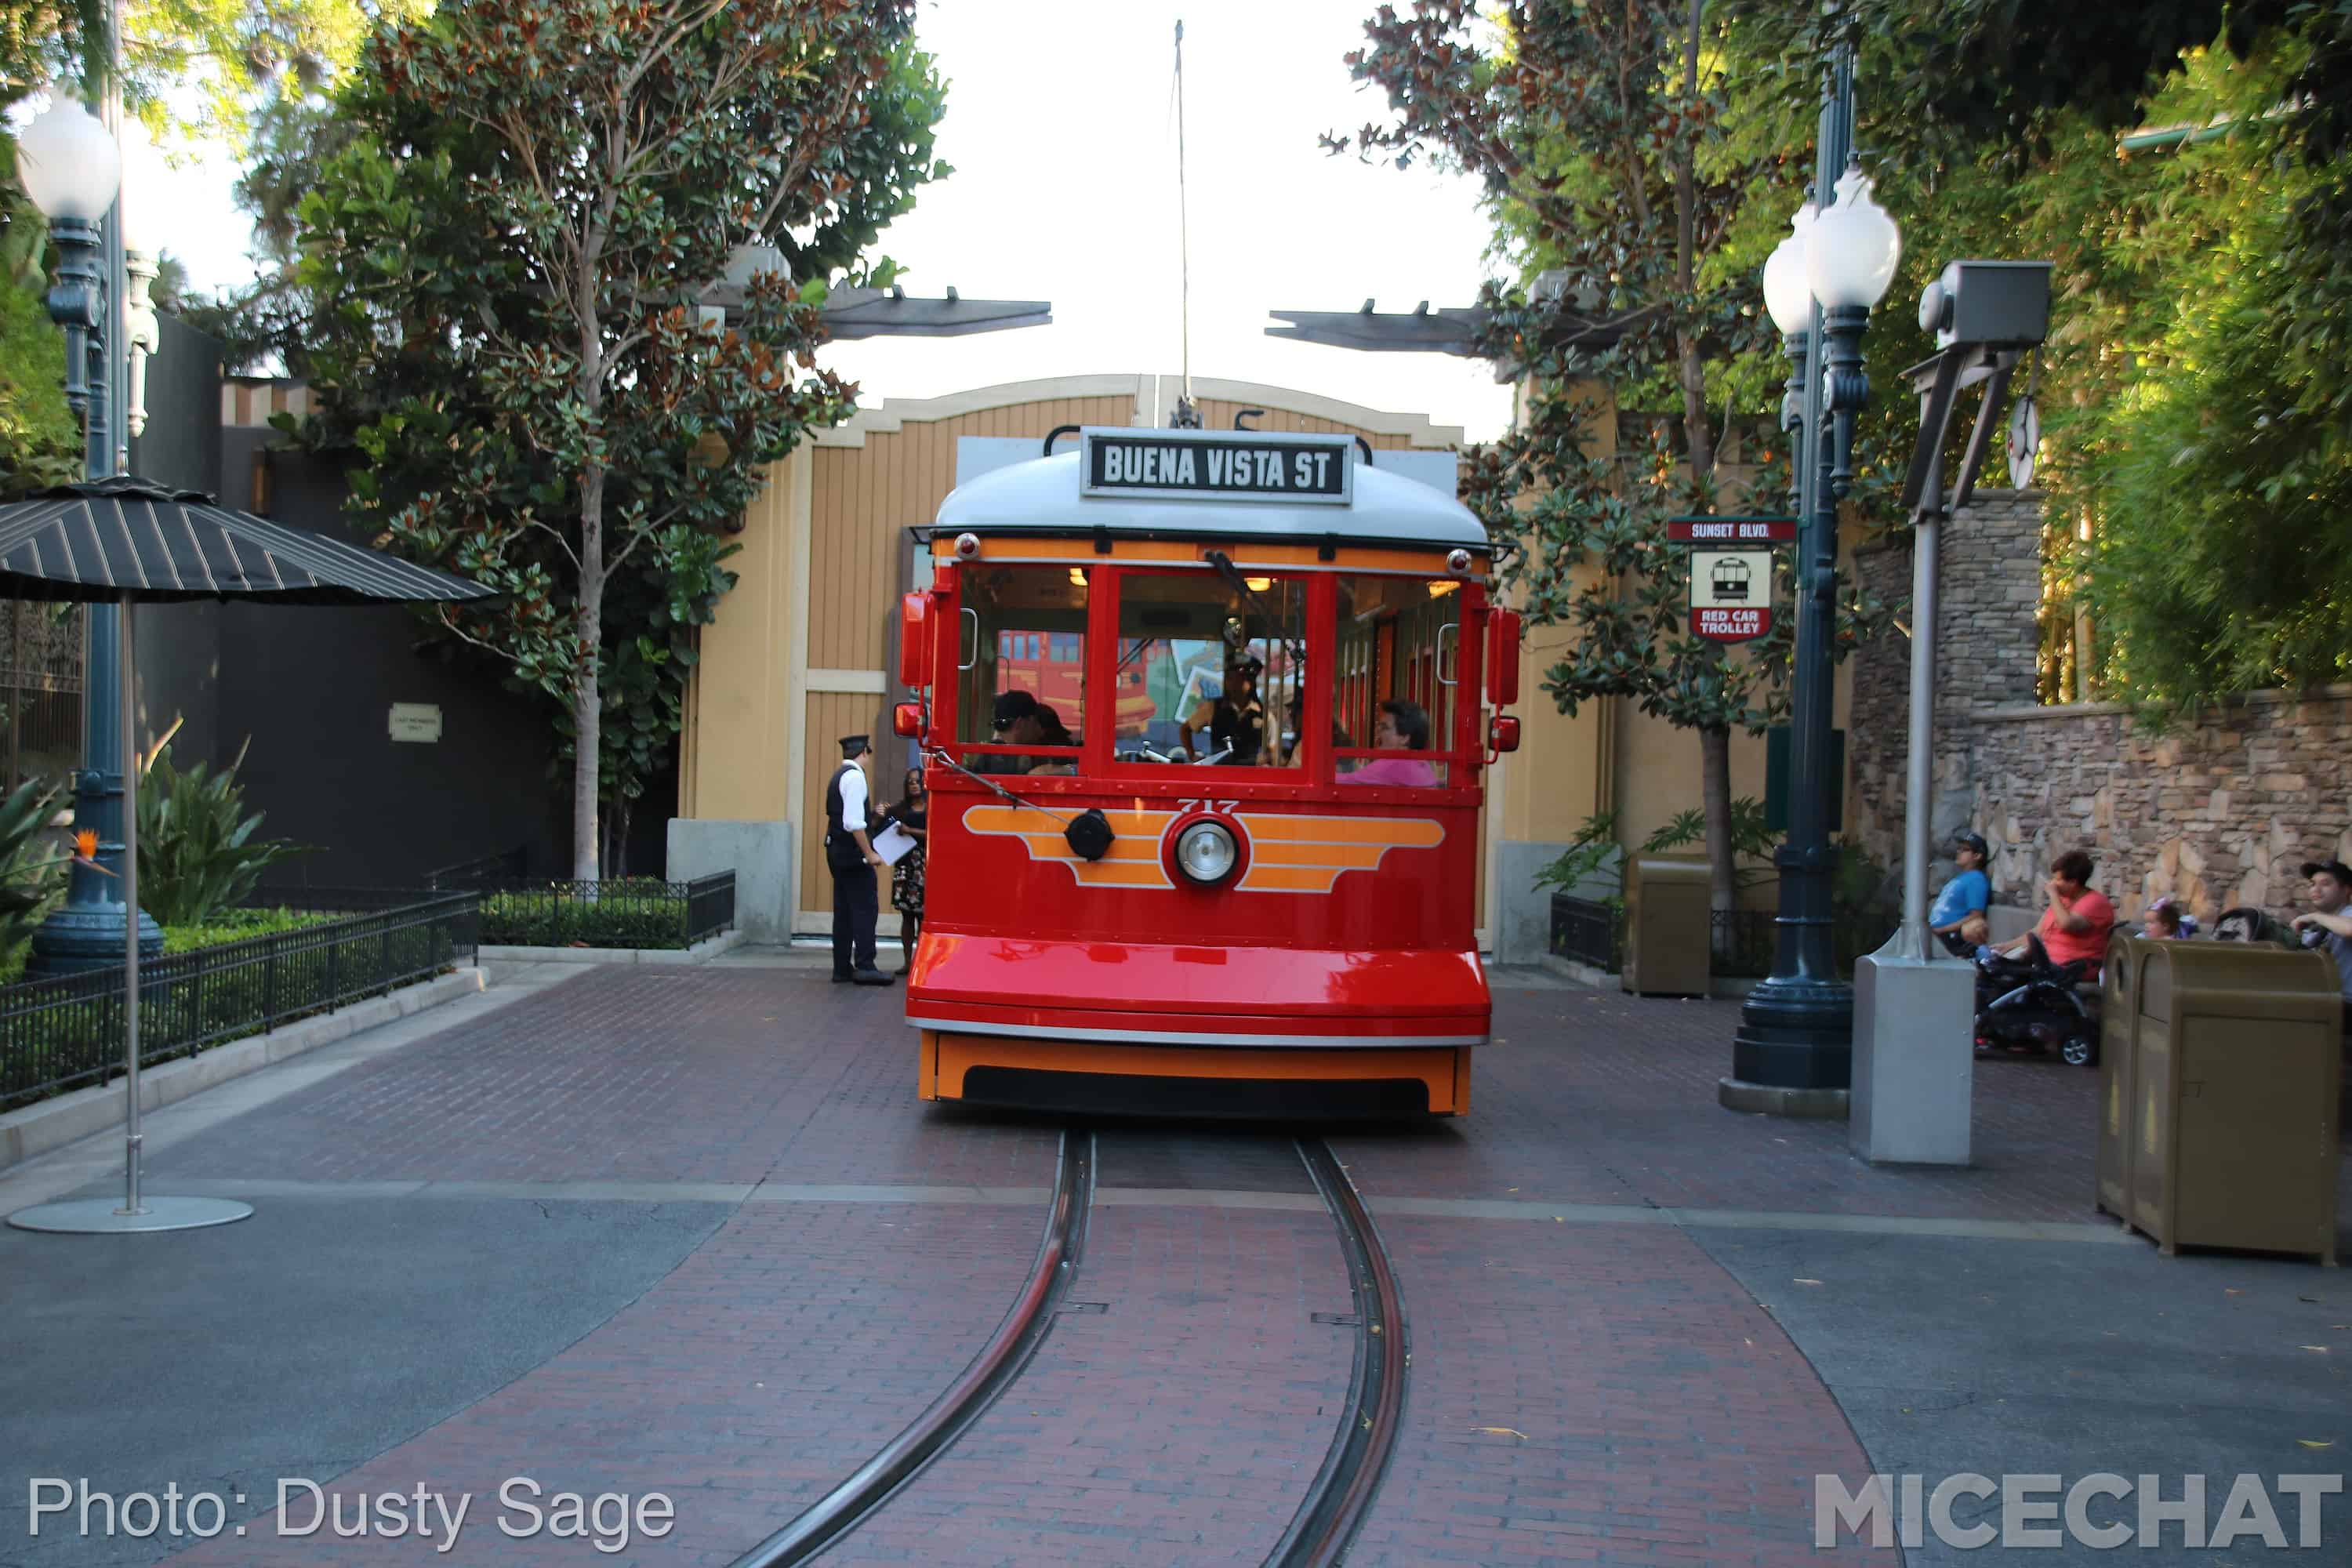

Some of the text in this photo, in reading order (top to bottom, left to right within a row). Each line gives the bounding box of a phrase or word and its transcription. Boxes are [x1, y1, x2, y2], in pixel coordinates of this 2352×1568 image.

[1104, 445, 1330, 490] BUENA VISTA ST
[1692, 524, 1769, 538] SUNSET BLVD.
[1701, 610, 1759, 622] RED CAR
[1700, 622, 1759, 633] TROLLEY
[1177, 798, 1240, 814] 717
